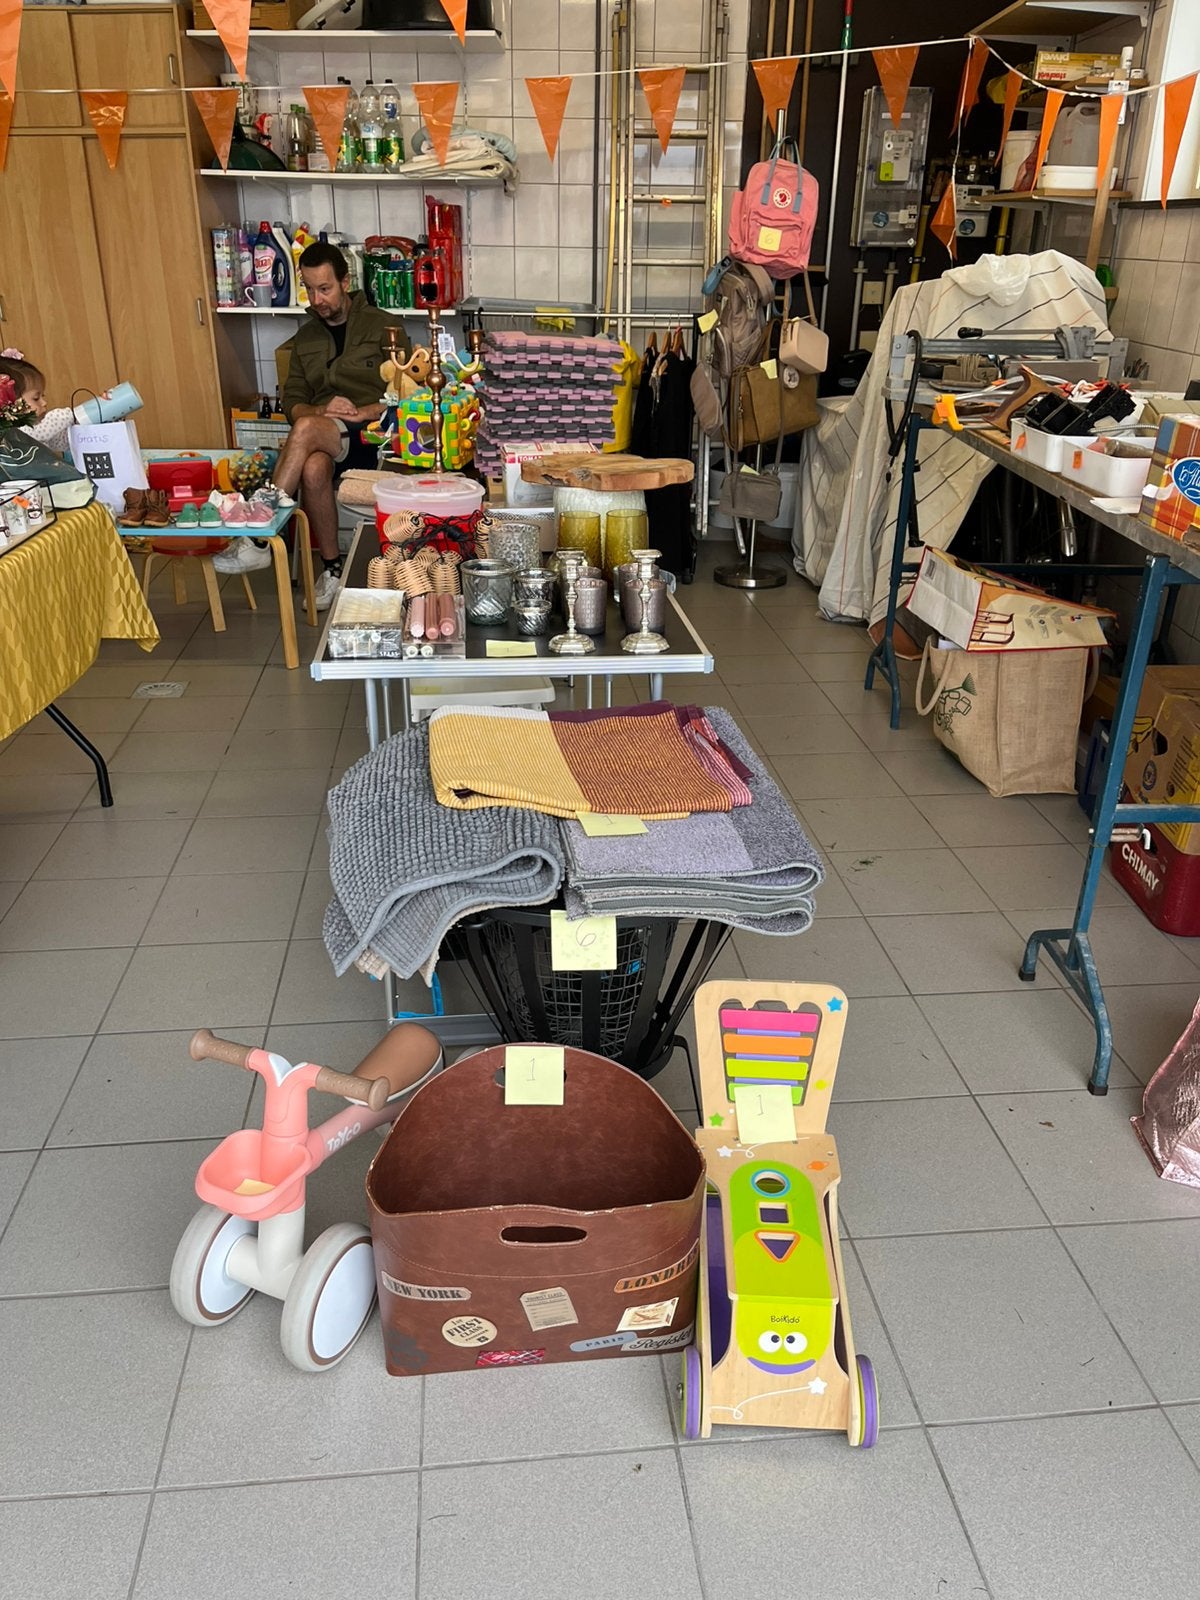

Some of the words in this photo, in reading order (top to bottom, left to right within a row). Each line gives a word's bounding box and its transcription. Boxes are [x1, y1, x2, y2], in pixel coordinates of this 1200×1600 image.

[1121, 843, 1159, 891] CHIMAY
[575, 919, 597, 947] 6
[526, 1057, 536, 1082] 1
[327, 1122, 361, 1152] TRYCO
[386, 1277, 412, 1296] NEW
[417, 1288, 463, 1299] YORK
[446, 1318, 482, 1337] FIRST
[460, 1325, 483, 1338] CLASS
[585, 1336, 625, 1348] PARIS
